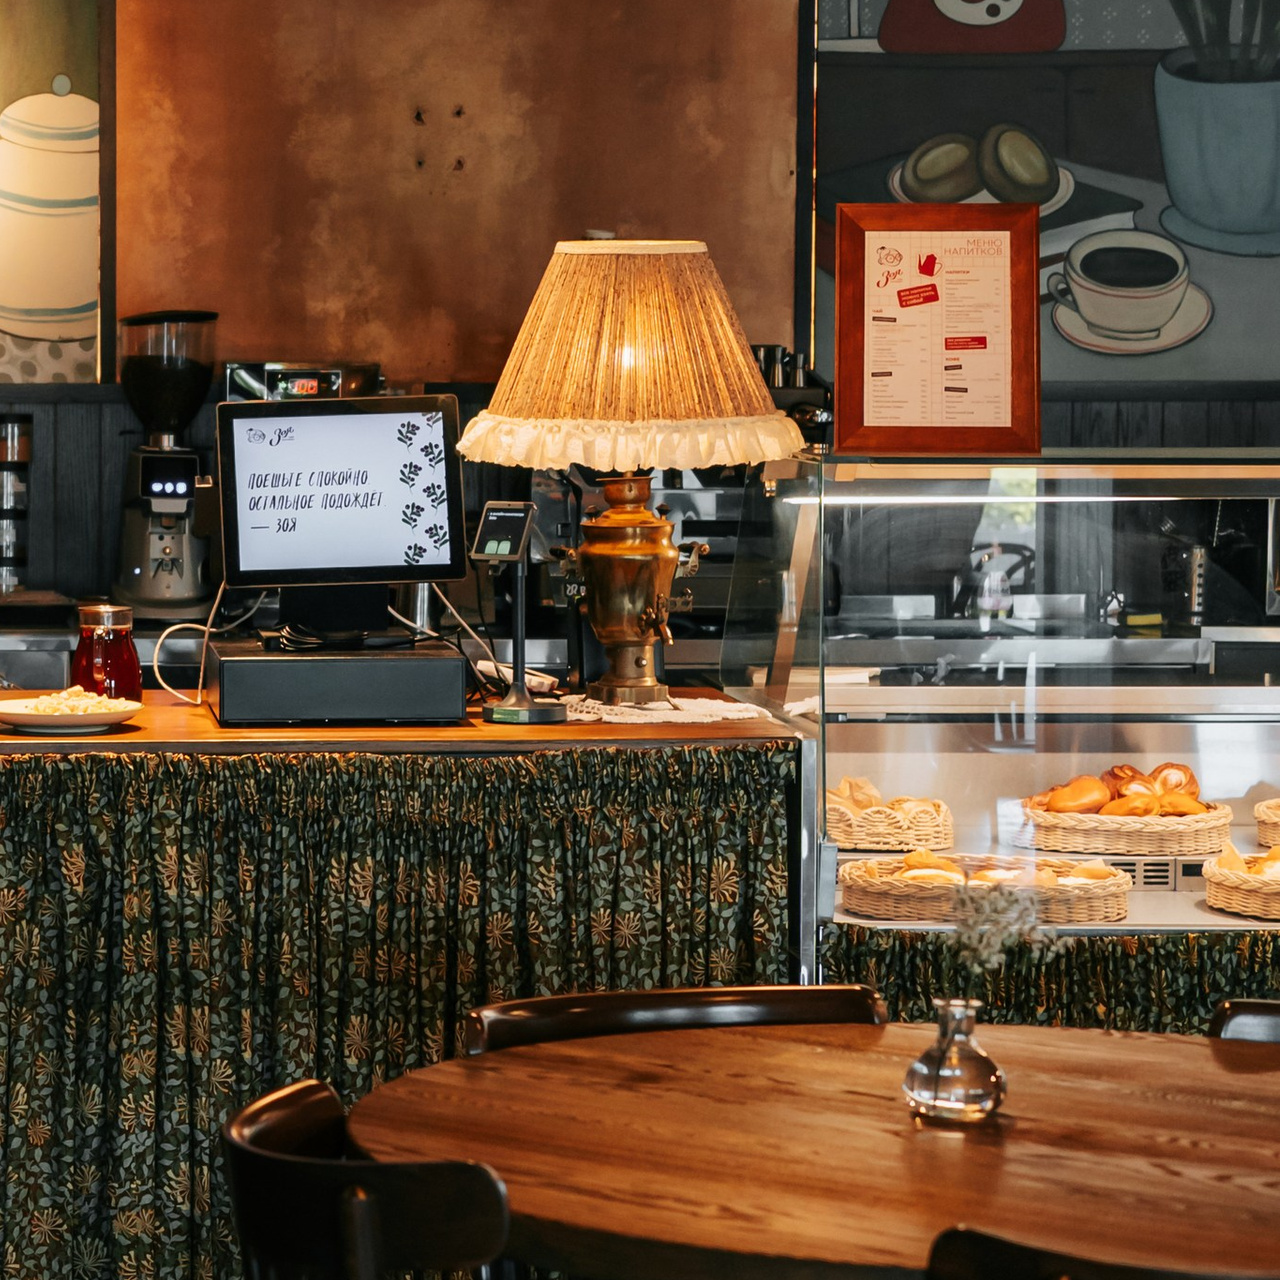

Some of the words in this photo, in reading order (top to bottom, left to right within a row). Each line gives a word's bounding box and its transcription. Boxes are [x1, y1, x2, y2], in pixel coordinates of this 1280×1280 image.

[966, 238, 1003, 248] МЕНЮ
[943, 247, 1003, 256] НАПИТКОВ
[248, 472, 302, 490] ПОЕШЬТЕ
[248, 494, 315, 511] ОСТАЛЬНОЕ
[276, 517, 297, 533] ЗОЯ
